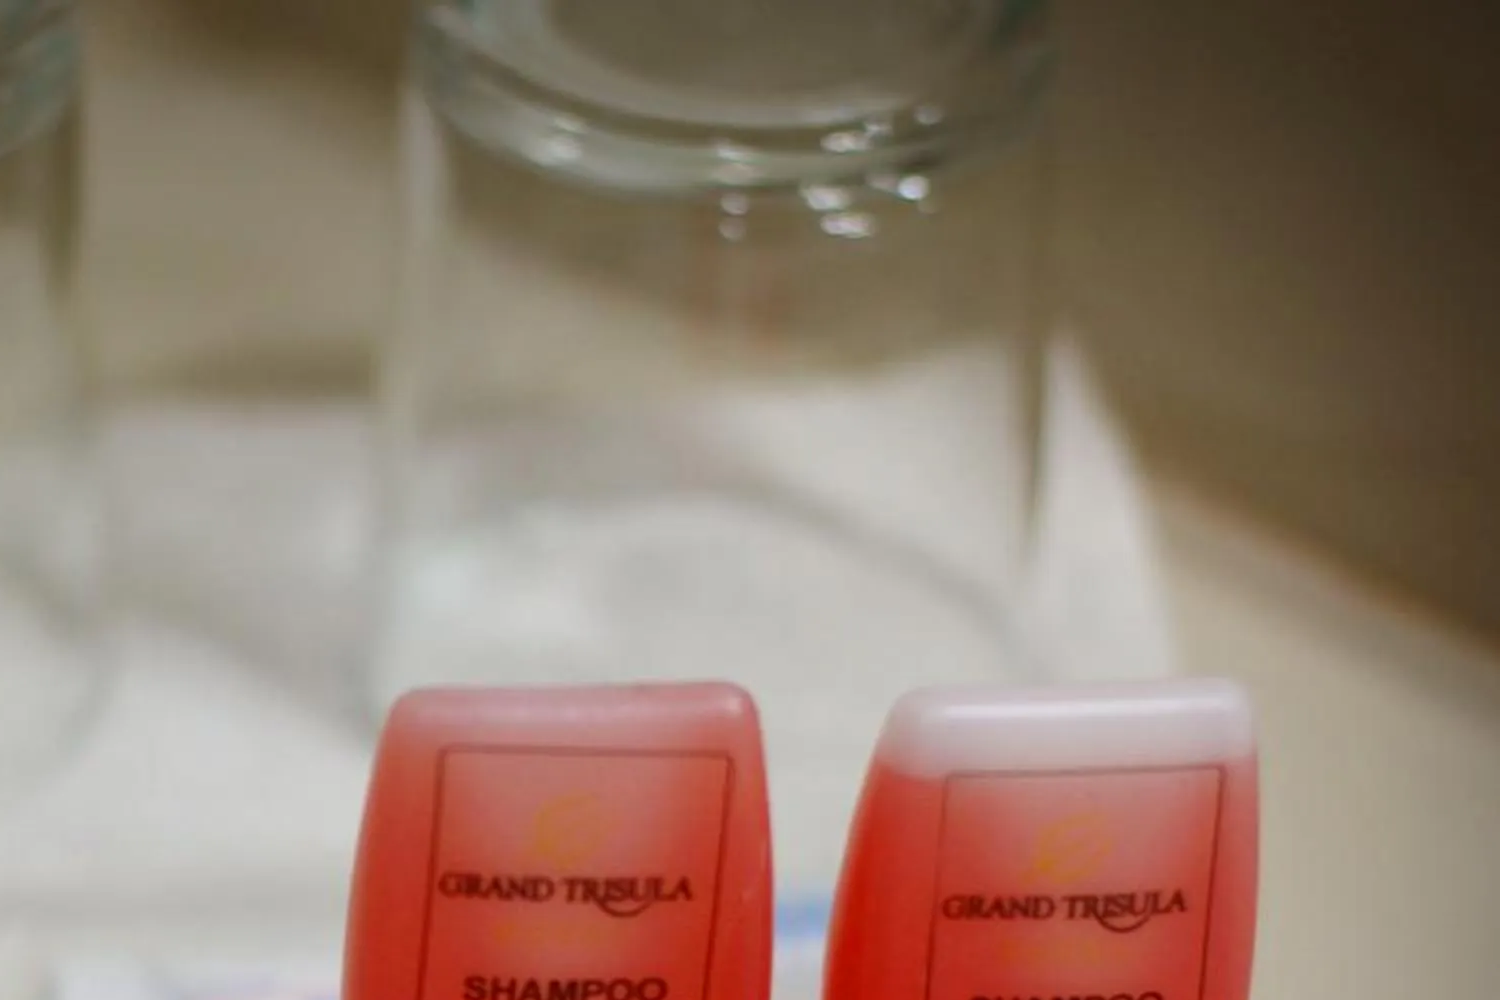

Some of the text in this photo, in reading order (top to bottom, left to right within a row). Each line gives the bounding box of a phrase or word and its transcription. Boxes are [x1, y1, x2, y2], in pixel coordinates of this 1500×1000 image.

[438, 872, 693, 917] GRAND TRISULA
[942, 889, 1188, 933] GRAND TRISULA
